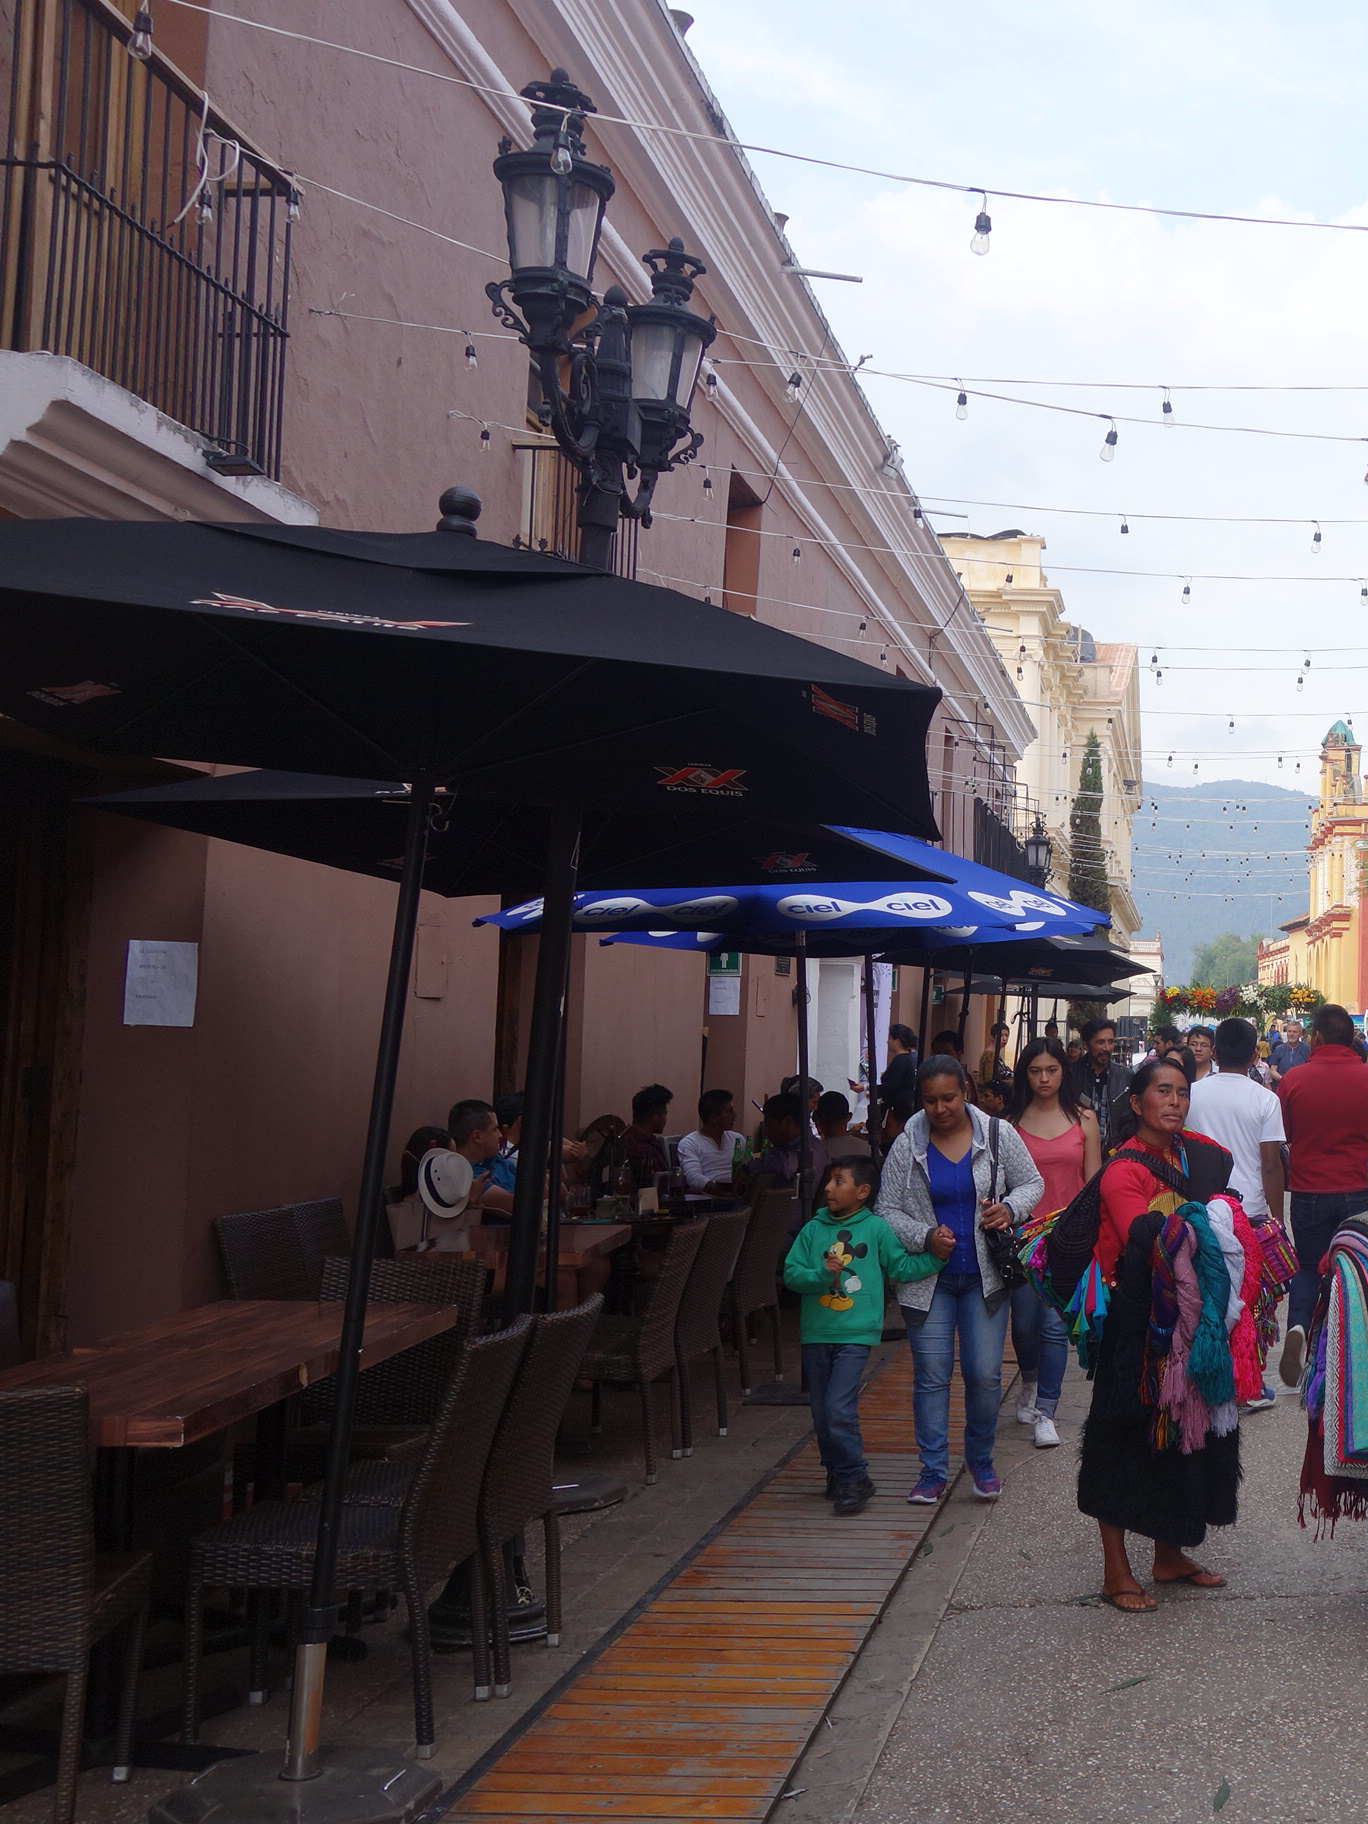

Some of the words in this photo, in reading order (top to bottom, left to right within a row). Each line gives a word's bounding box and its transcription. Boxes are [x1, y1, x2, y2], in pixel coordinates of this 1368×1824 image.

[701, 788, 744, 797] EQUIS
[584, 904, 640, 916] ciel
[673, 903, 728, 916] ciel
[787, 900, 842, 914] ciel
[886, 898, 941, 911] ciel
